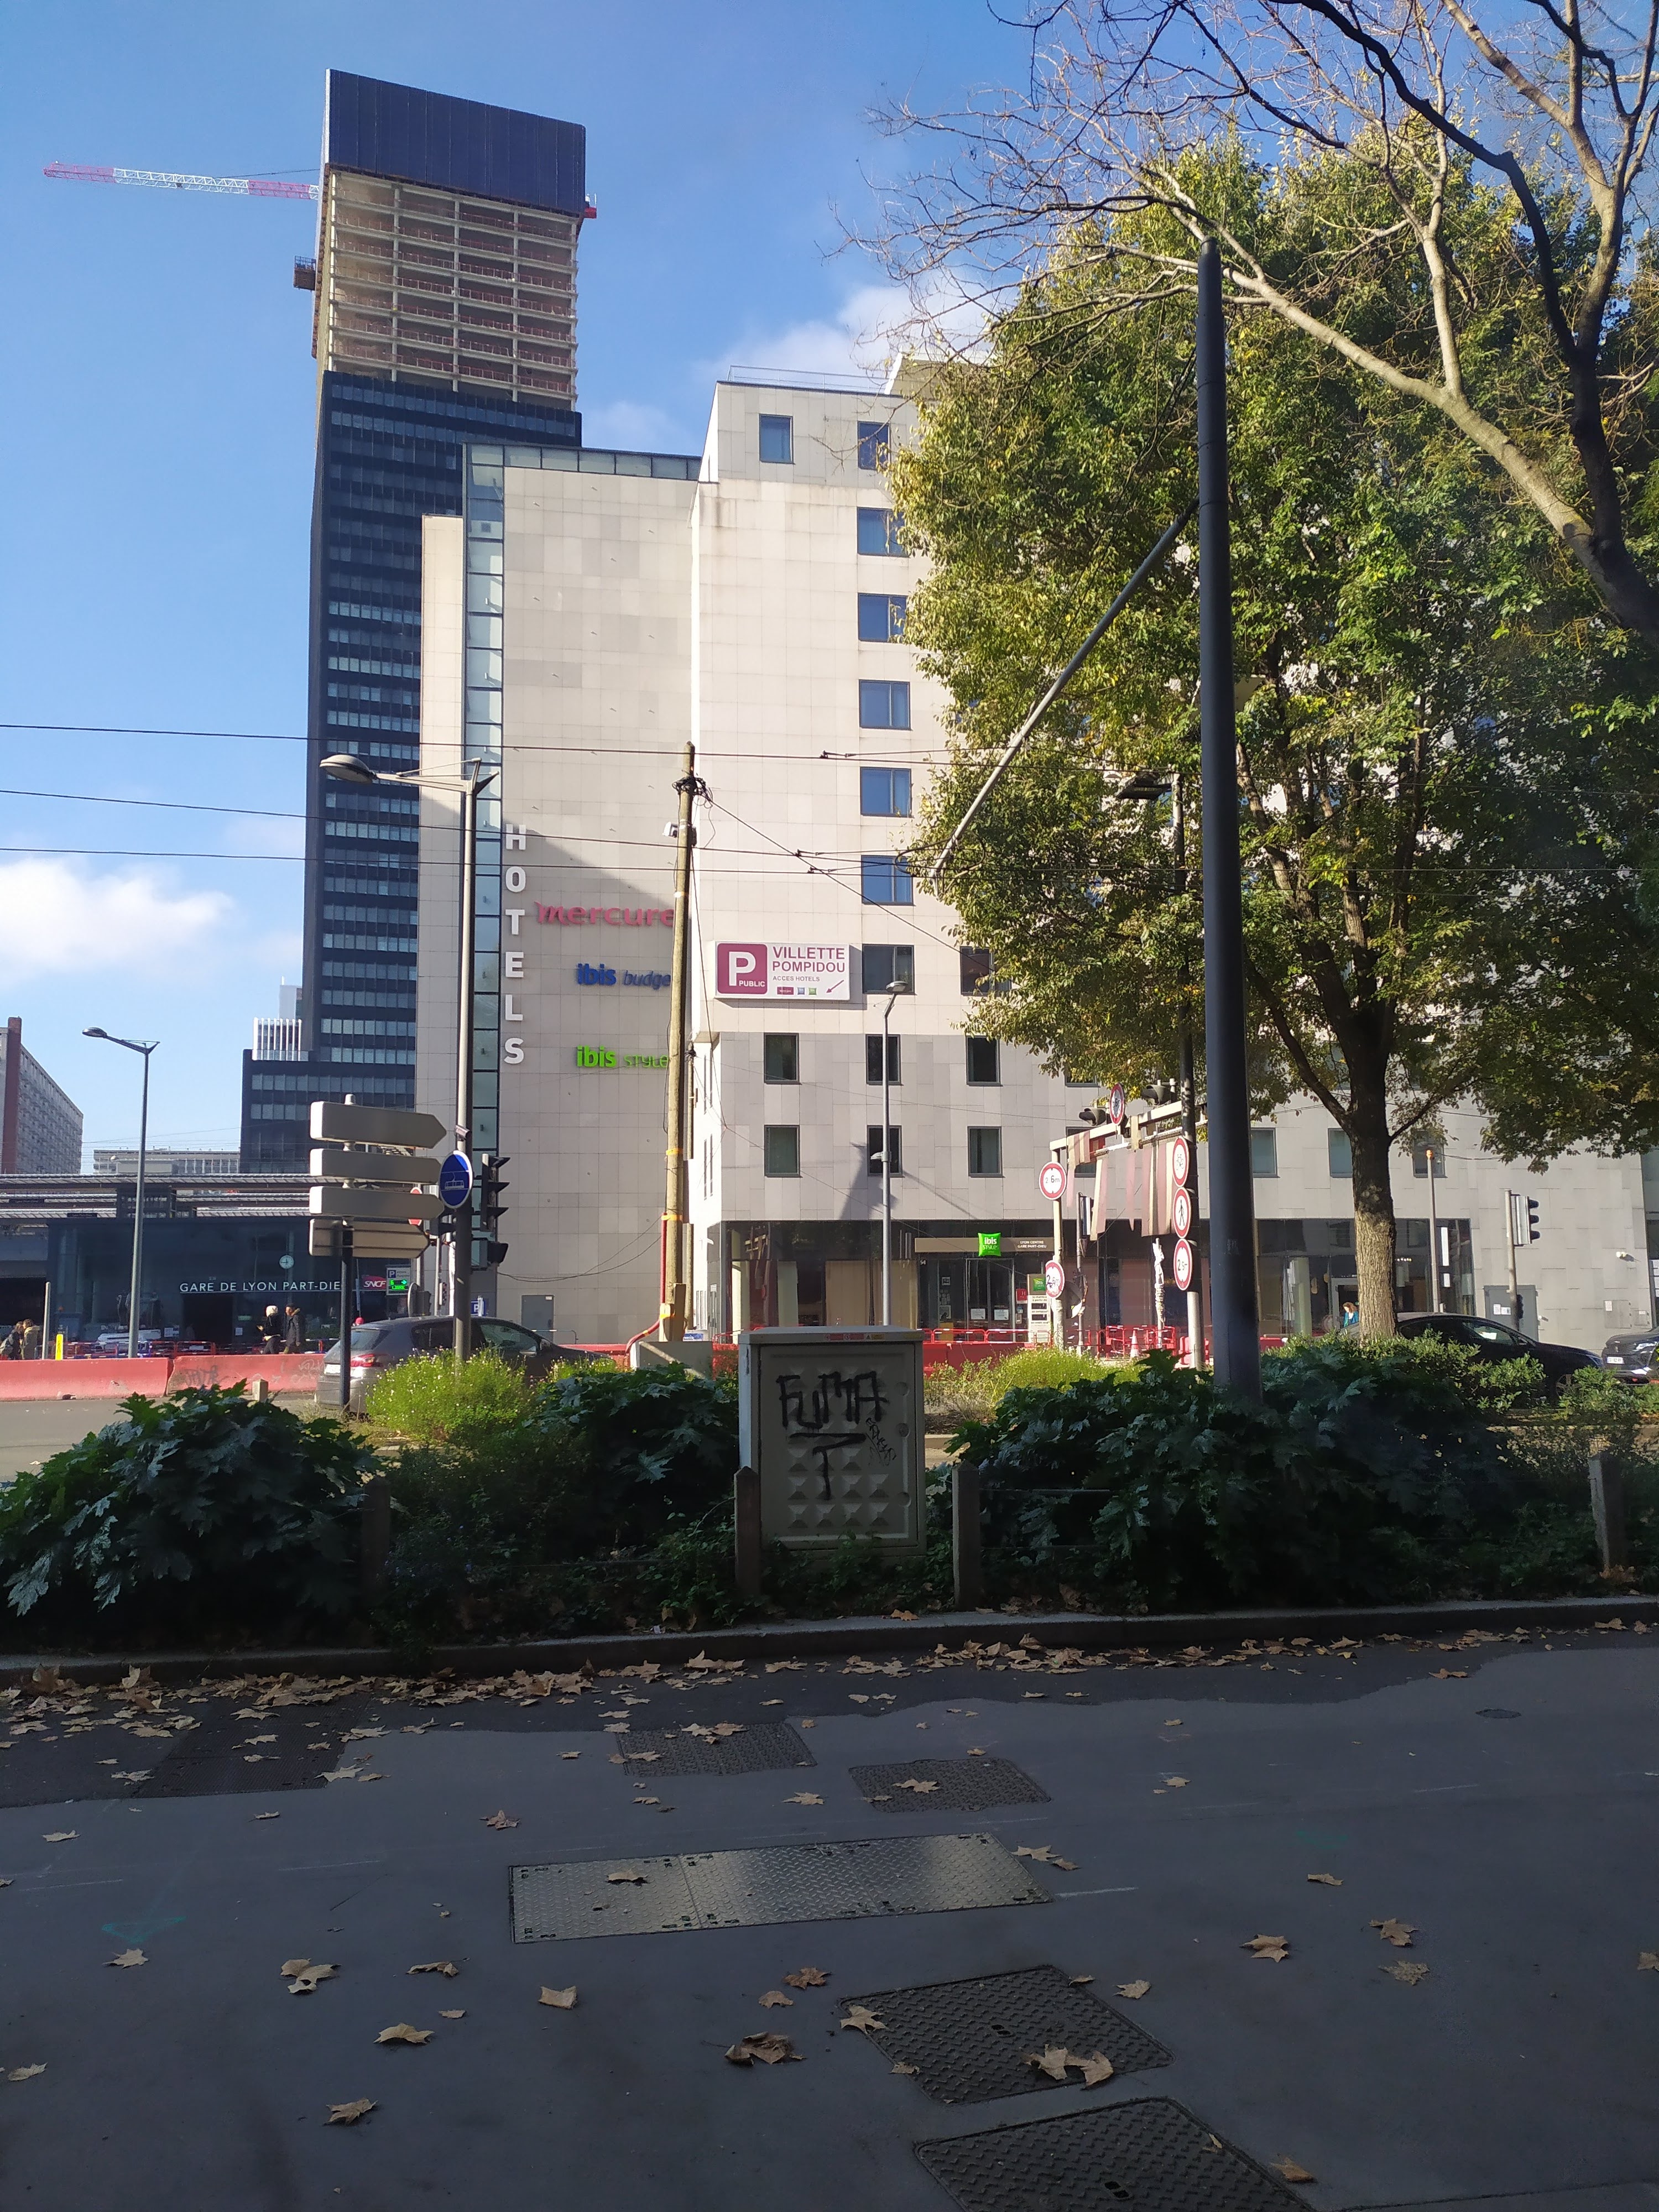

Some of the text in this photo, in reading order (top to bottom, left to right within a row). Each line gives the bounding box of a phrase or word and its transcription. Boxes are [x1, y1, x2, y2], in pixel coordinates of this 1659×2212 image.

[504, 824, 526, 1064] HOTELS
[773, 946, 845, 959] VILLETTE
[729, 951, 756, 987] P
[773, 961, 845, 973] POMPIDOU
[577, 963, 671, 990] ibis budge
[577, 1045, 669, 1068] ibis STYLE
[984, 1237, 997, 1245] ibis
[180, 1281, 341, 1292] GARE DE LYON PART-DIE
